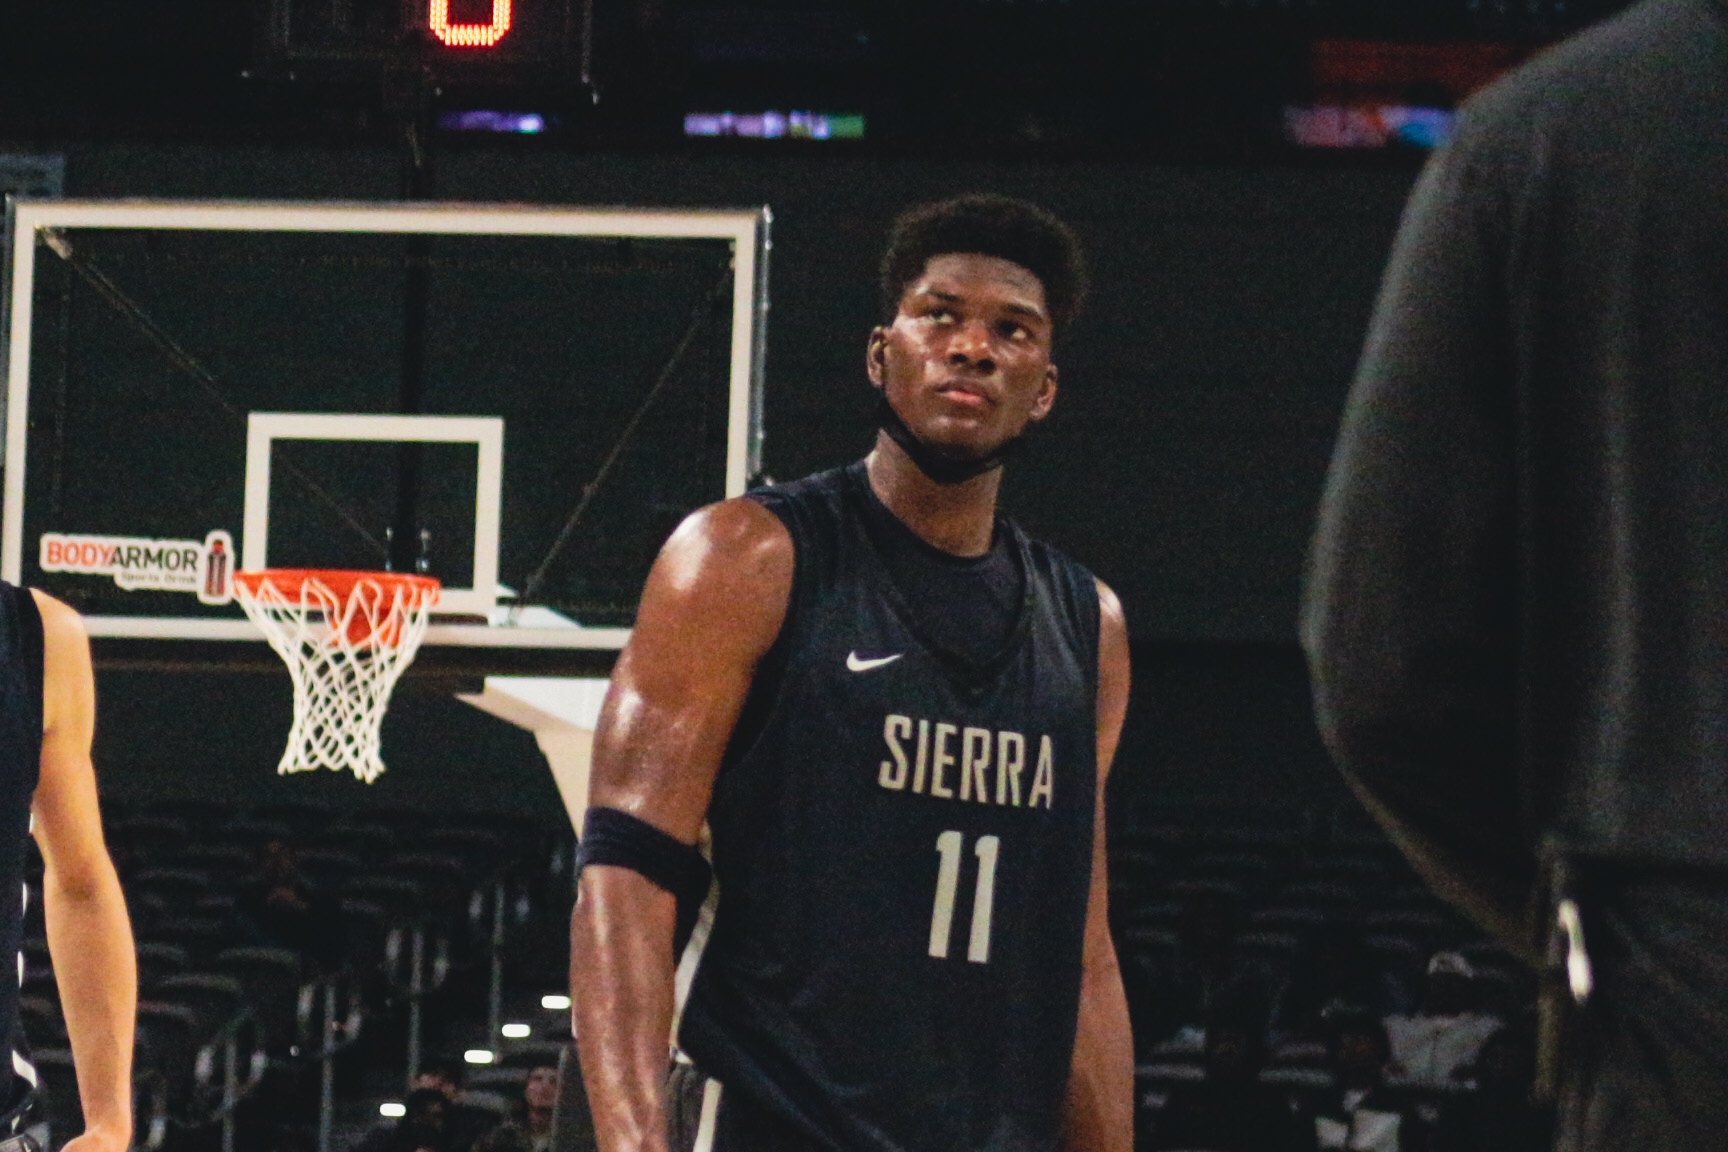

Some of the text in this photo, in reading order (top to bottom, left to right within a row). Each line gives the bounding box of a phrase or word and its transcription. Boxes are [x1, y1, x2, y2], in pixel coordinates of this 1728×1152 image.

[46, 540, 198, 571] BODYARMOR
[877, 713, 1054, 810] SIERRA
[927, 830, 1001, 963] 11
